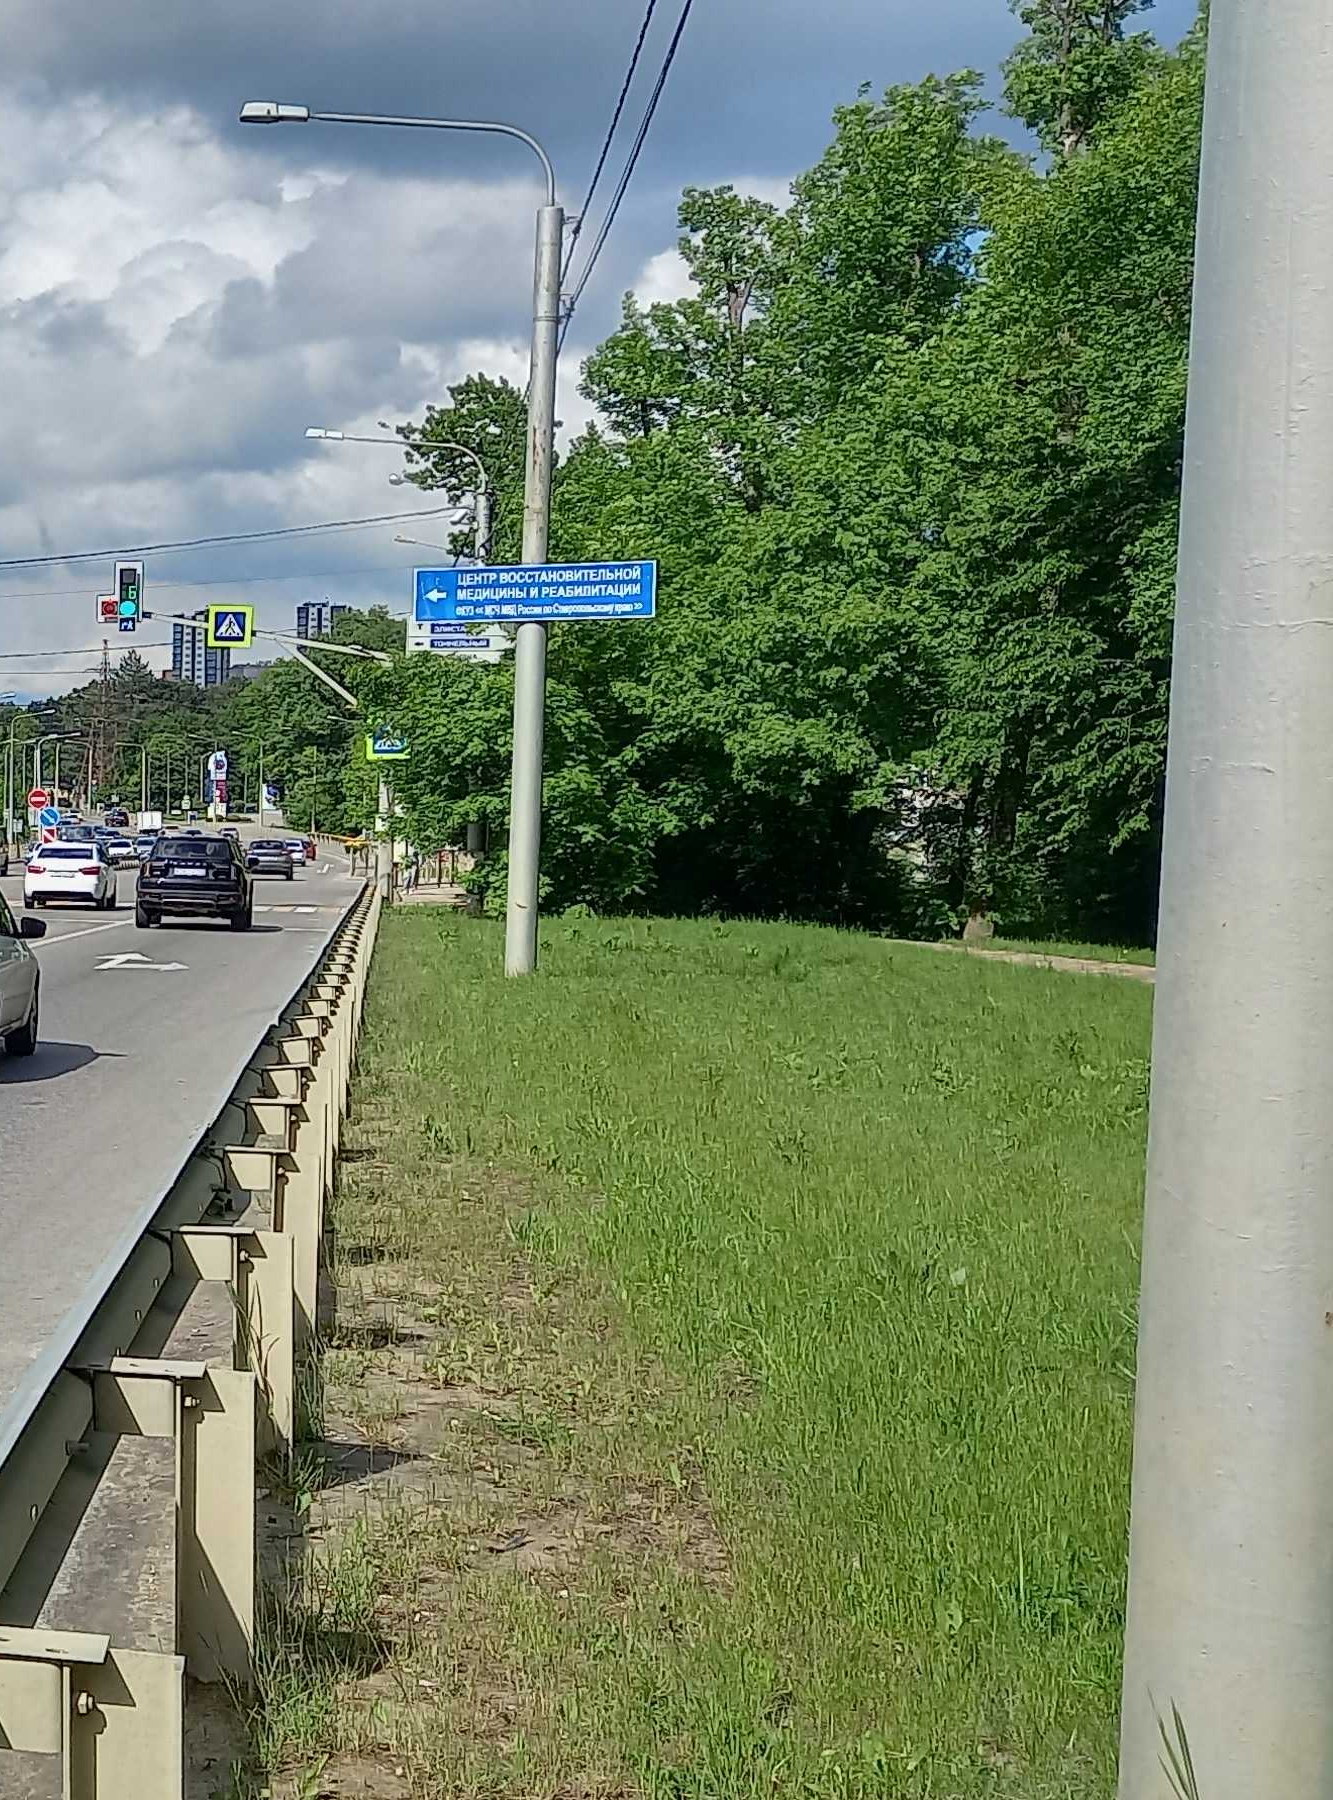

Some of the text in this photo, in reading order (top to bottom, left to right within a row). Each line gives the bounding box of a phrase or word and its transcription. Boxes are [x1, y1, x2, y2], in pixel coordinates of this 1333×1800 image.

[457, 565, 641, 587] ЦЕНТР ВОССТАНОВИТЕЛЬНОЙ
[456, 582, 641, 602] МЕДИЦИНЫ И РЕАБИЛИТАЦИИ
